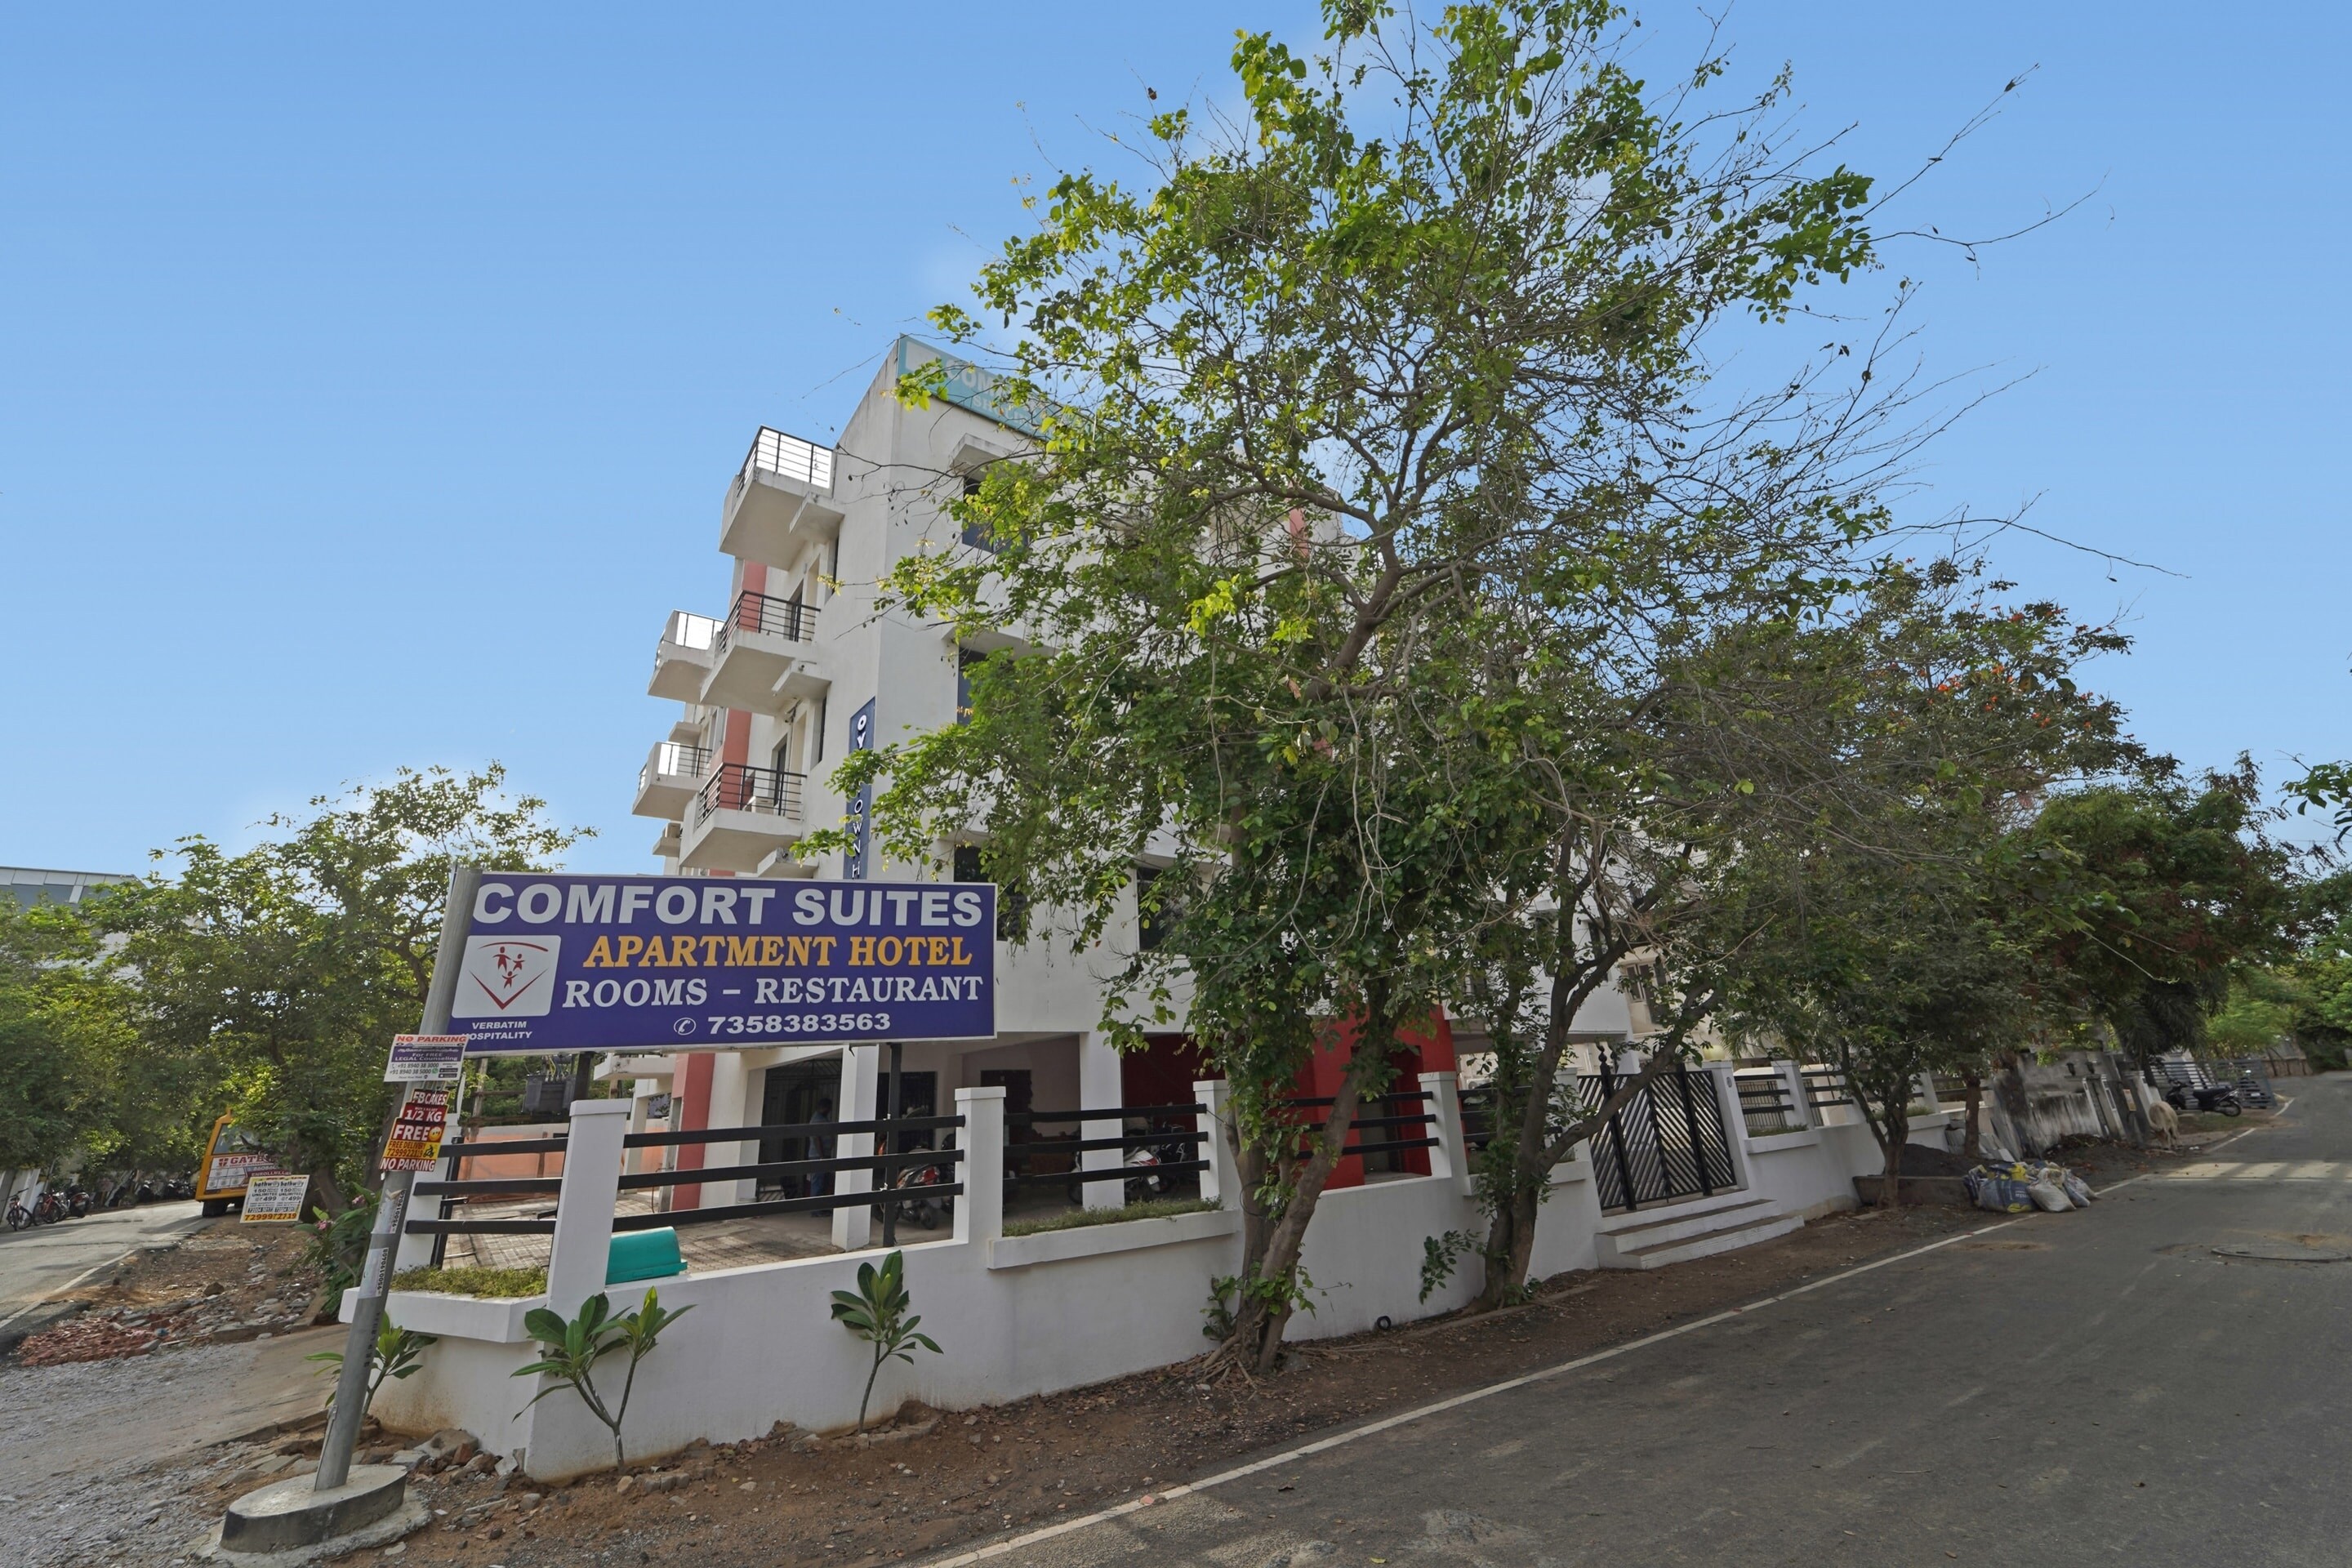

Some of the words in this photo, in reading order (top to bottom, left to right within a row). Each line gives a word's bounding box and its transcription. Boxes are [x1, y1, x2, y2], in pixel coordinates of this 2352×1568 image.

[473, 883, 775, 925] COMFORT
[792, 889, 982, 927] SUITES
[582, 935, 837, 967] APARTMENT
[849, 936, 973, 966] HOTEL
[562, 978, 707, 1008] ROOMS
[754, 976, 983, 1004] RESTAURANT
[472, 1021, 527, 1030] VERBATIM
[708, 1013, 890, 1035] 7358383563
[425, 1093, 447, 1105] CAKES
[404, 1109, 424, 1120] 1/2
[426, 1111, 443, 1122] KG
[393, 1125, 430, 1141] FREE
[388, 1140, 403, 1148] FREE
[380, 1158, 396, 1169] NO
[397, 1159, 435, 1171] PARKING
